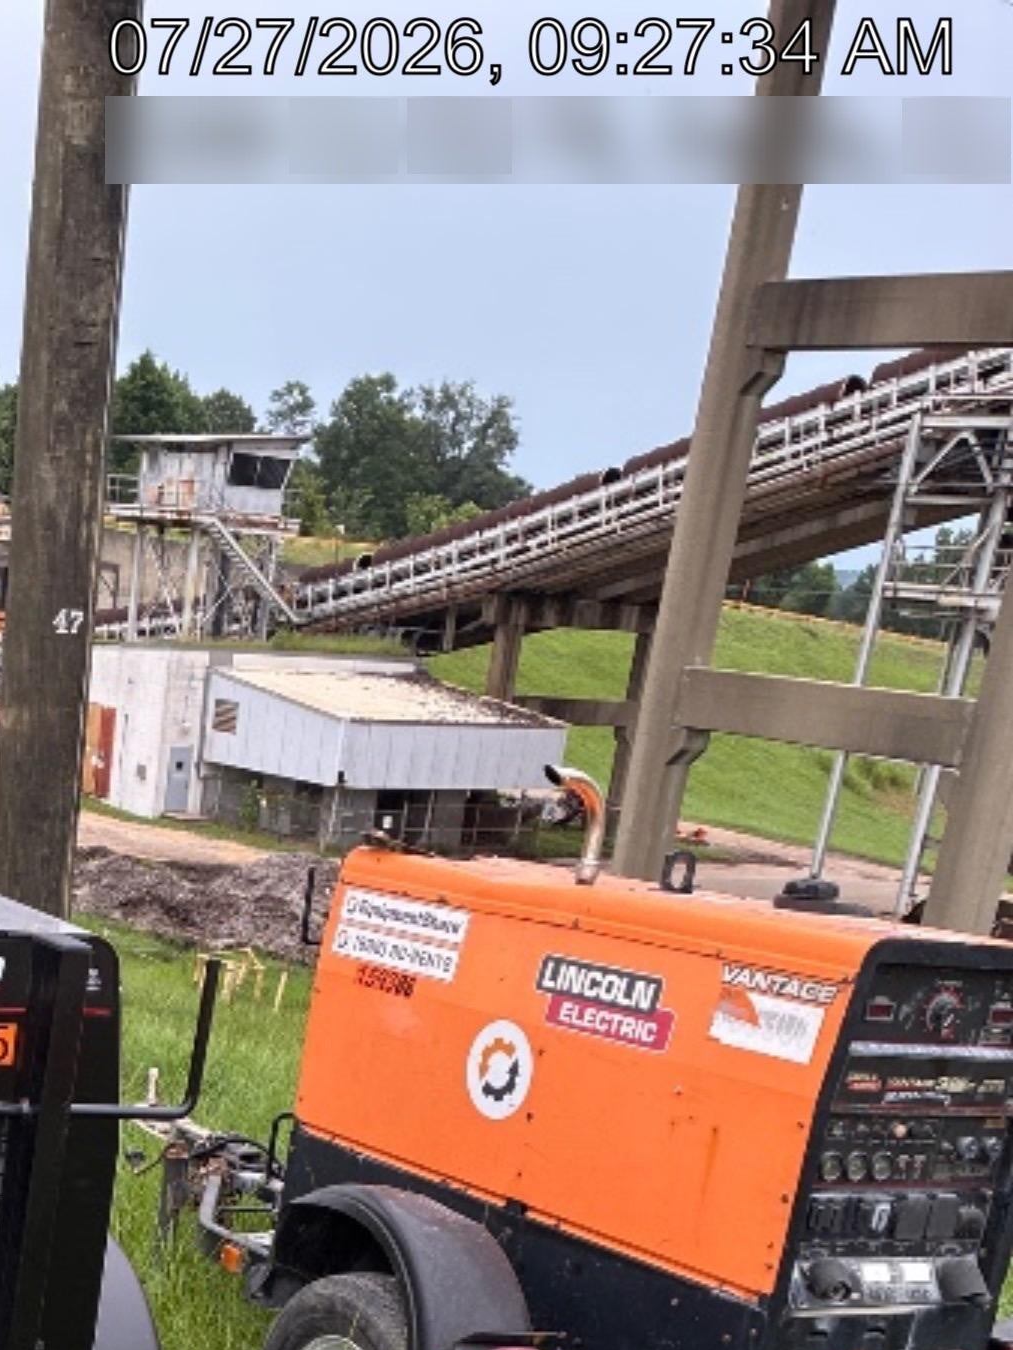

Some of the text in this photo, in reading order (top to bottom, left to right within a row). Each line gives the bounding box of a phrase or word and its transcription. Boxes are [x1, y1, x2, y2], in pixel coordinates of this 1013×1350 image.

[52, 608, 84, 634] 47
[541, 959, 658, 1011] LINCOLN
[721, 963, 839, 1005] VANTAGE
[558, 1001, 659, 1043] ELECTRIC
